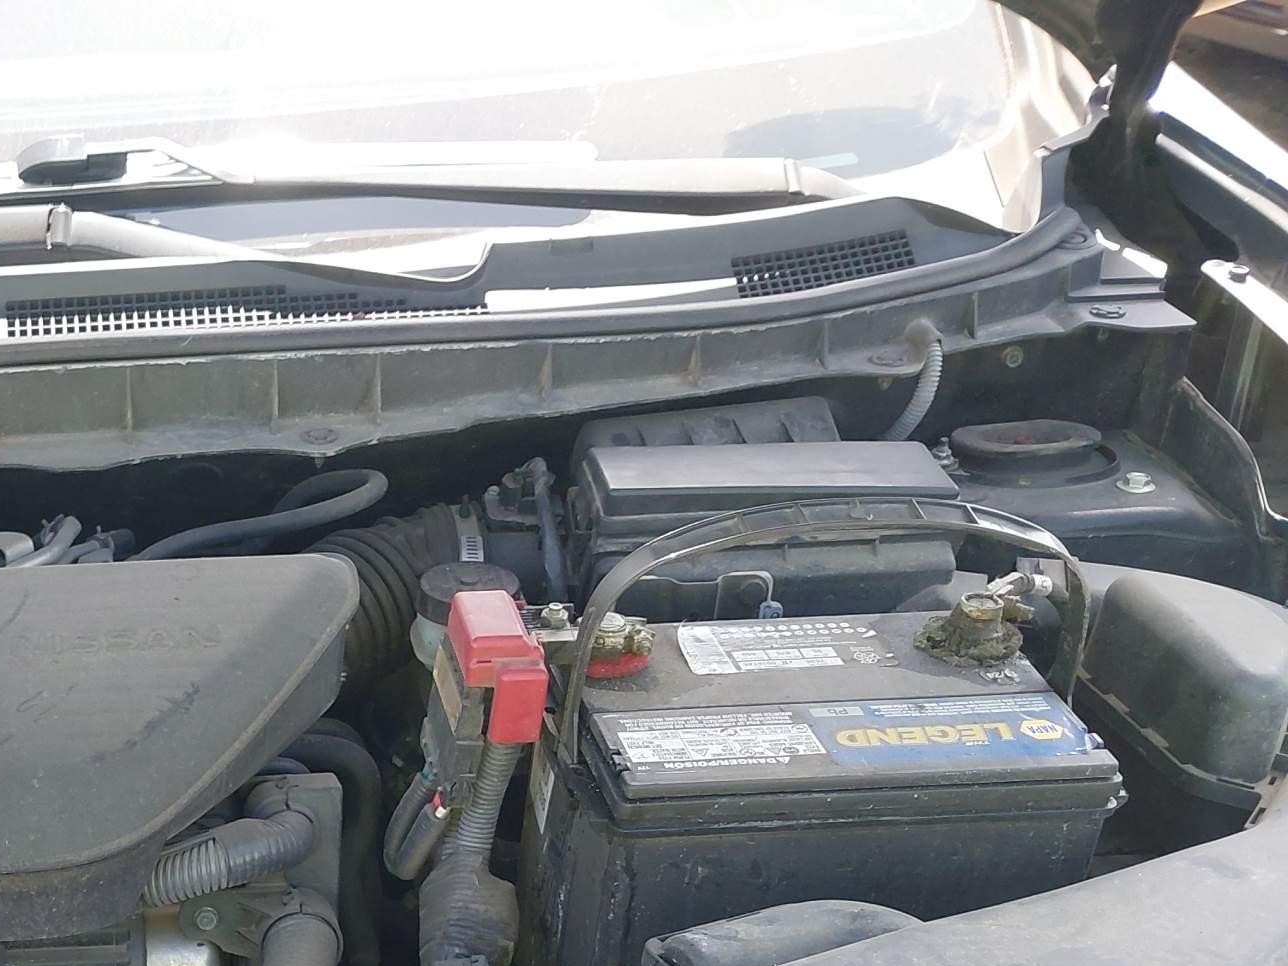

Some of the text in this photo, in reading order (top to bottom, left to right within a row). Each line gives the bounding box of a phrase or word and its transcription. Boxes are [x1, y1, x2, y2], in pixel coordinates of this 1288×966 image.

[836, 722, 1014, 746] LEGEND
[1027, 725, 1059, 734] NAPA
[664, 758, 777, 770] DANGER/POISON
